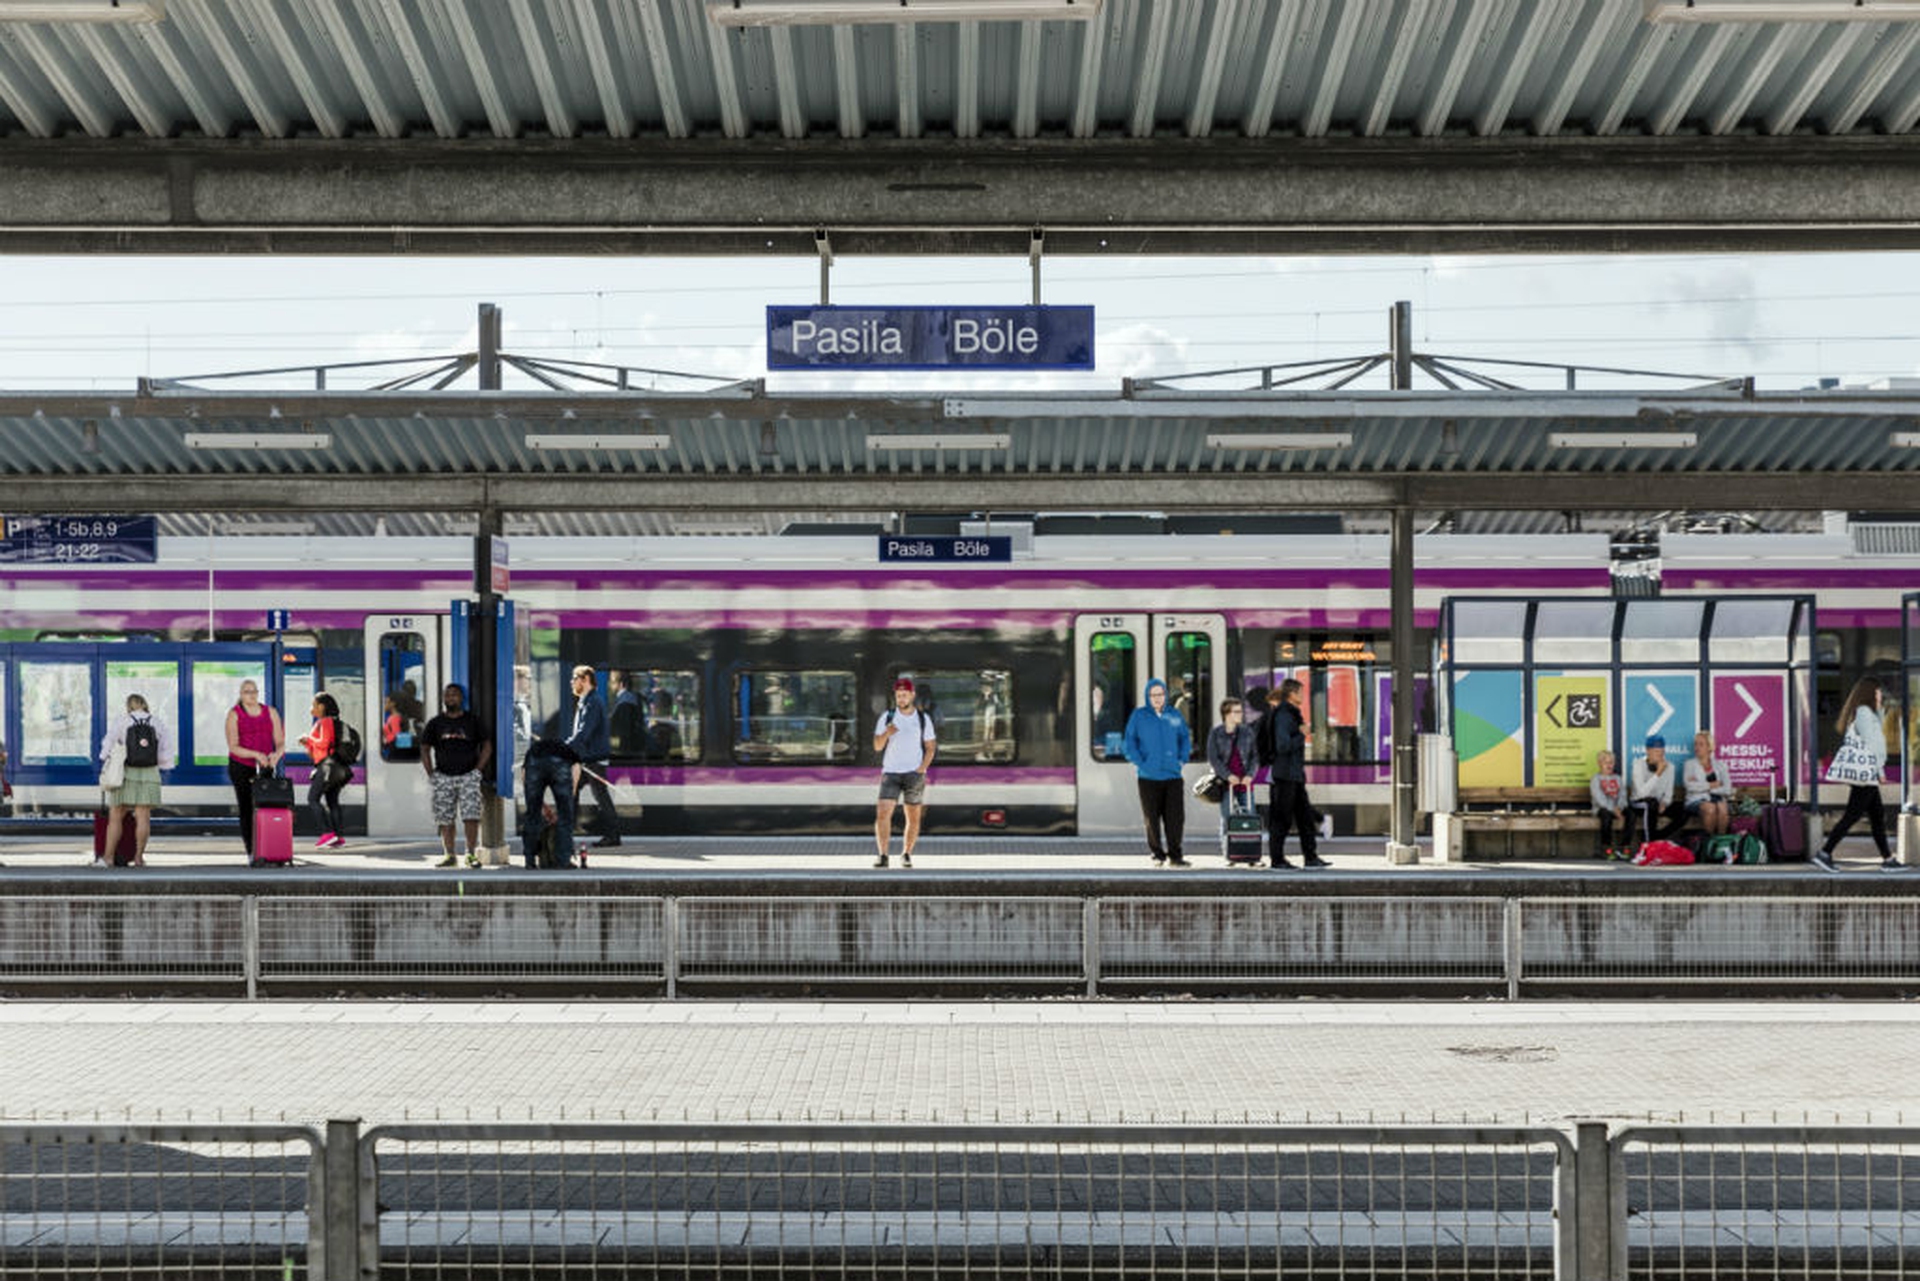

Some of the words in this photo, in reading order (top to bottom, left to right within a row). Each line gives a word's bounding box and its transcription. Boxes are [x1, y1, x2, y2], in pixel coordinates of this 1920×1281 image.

[792, 319, 902, 353] Pasila
[954, 319, 1038, 353] Böle
[55, 522, 118, 538] 1-5b,8,9
[55, 543, 100, 558] 21-22
[888, 541, 934, 556] Pasila
[953, 541, 990, 556] Böle
[1720, 744, 1773, 756] MESSU-
